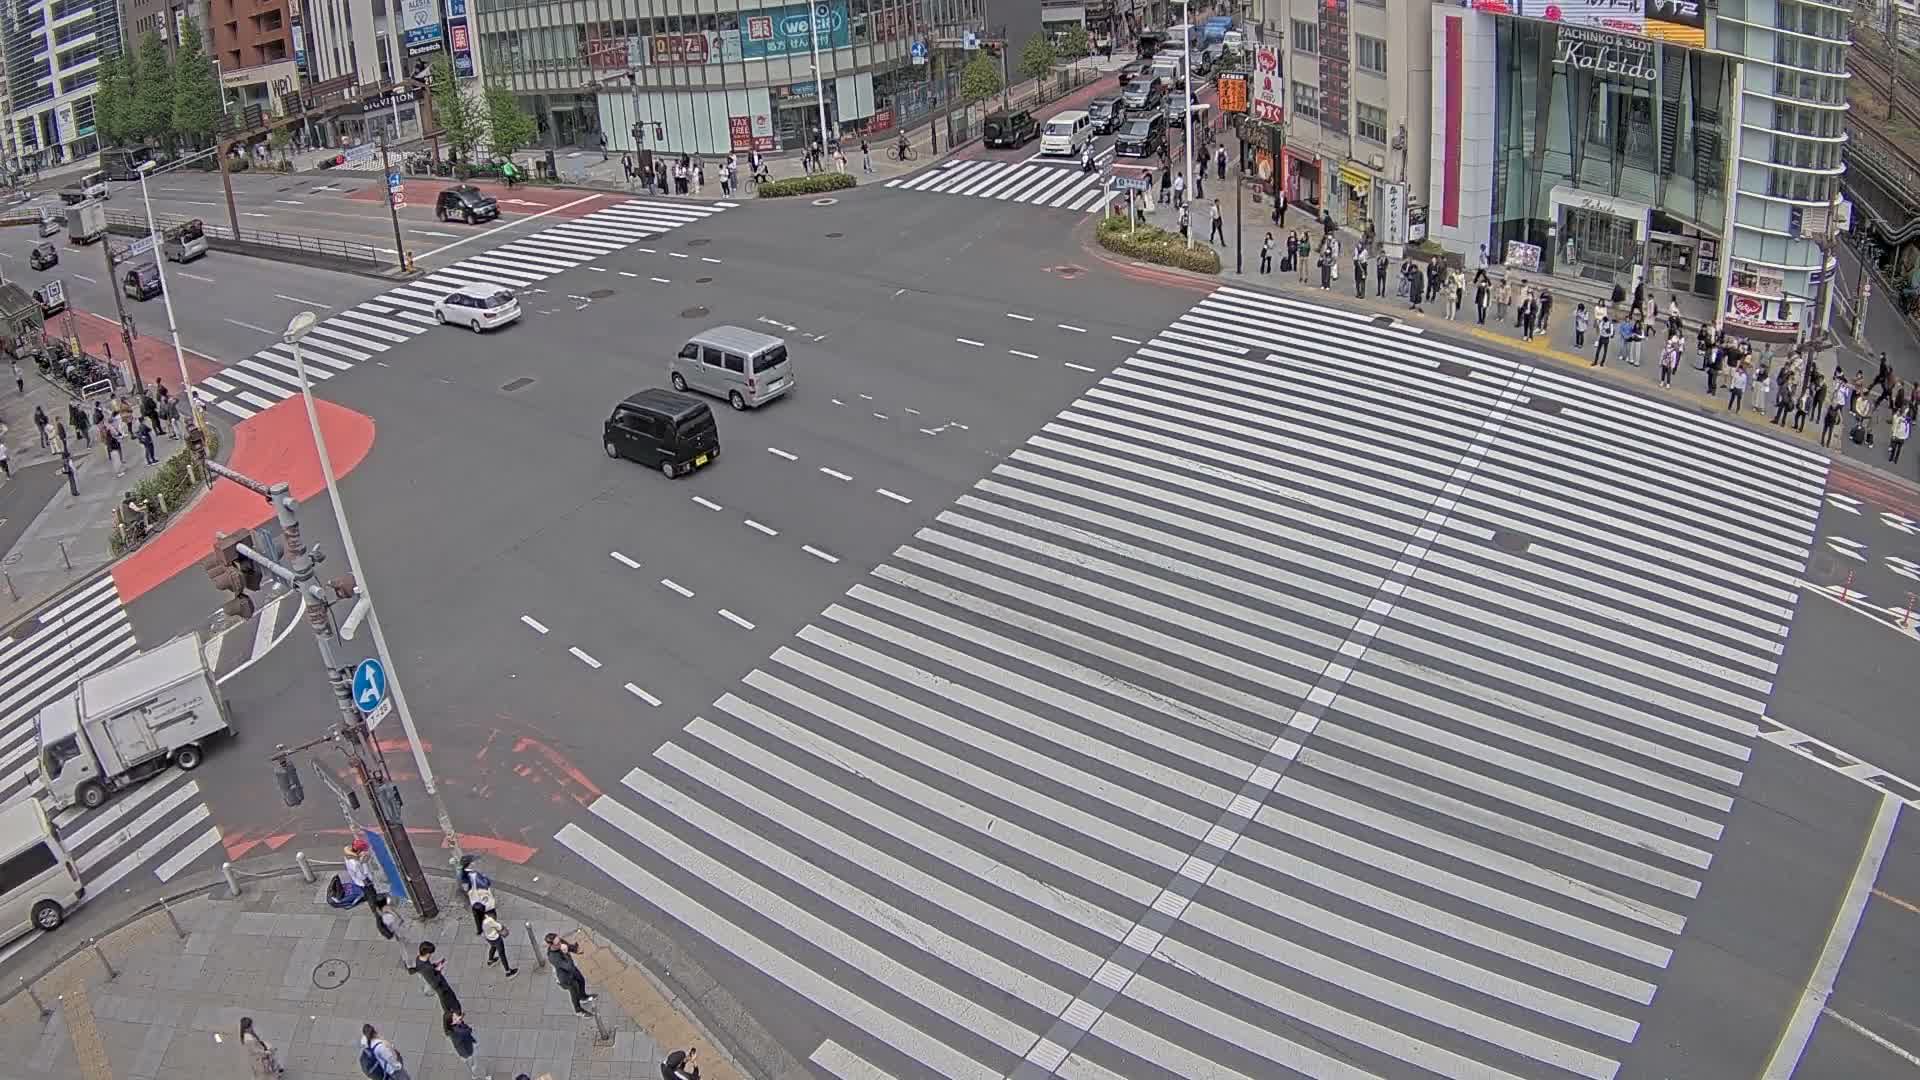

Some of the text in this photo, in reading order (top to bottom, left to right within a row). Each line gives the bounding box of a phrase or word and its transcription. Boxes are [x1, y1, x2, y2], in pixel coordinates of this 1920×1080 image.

[1558, 27, 1654, 51] PACHINKO & SLOT
[1552, 40, 1657, 80] Kaleido
[733, 119, 748, 127] TAX
